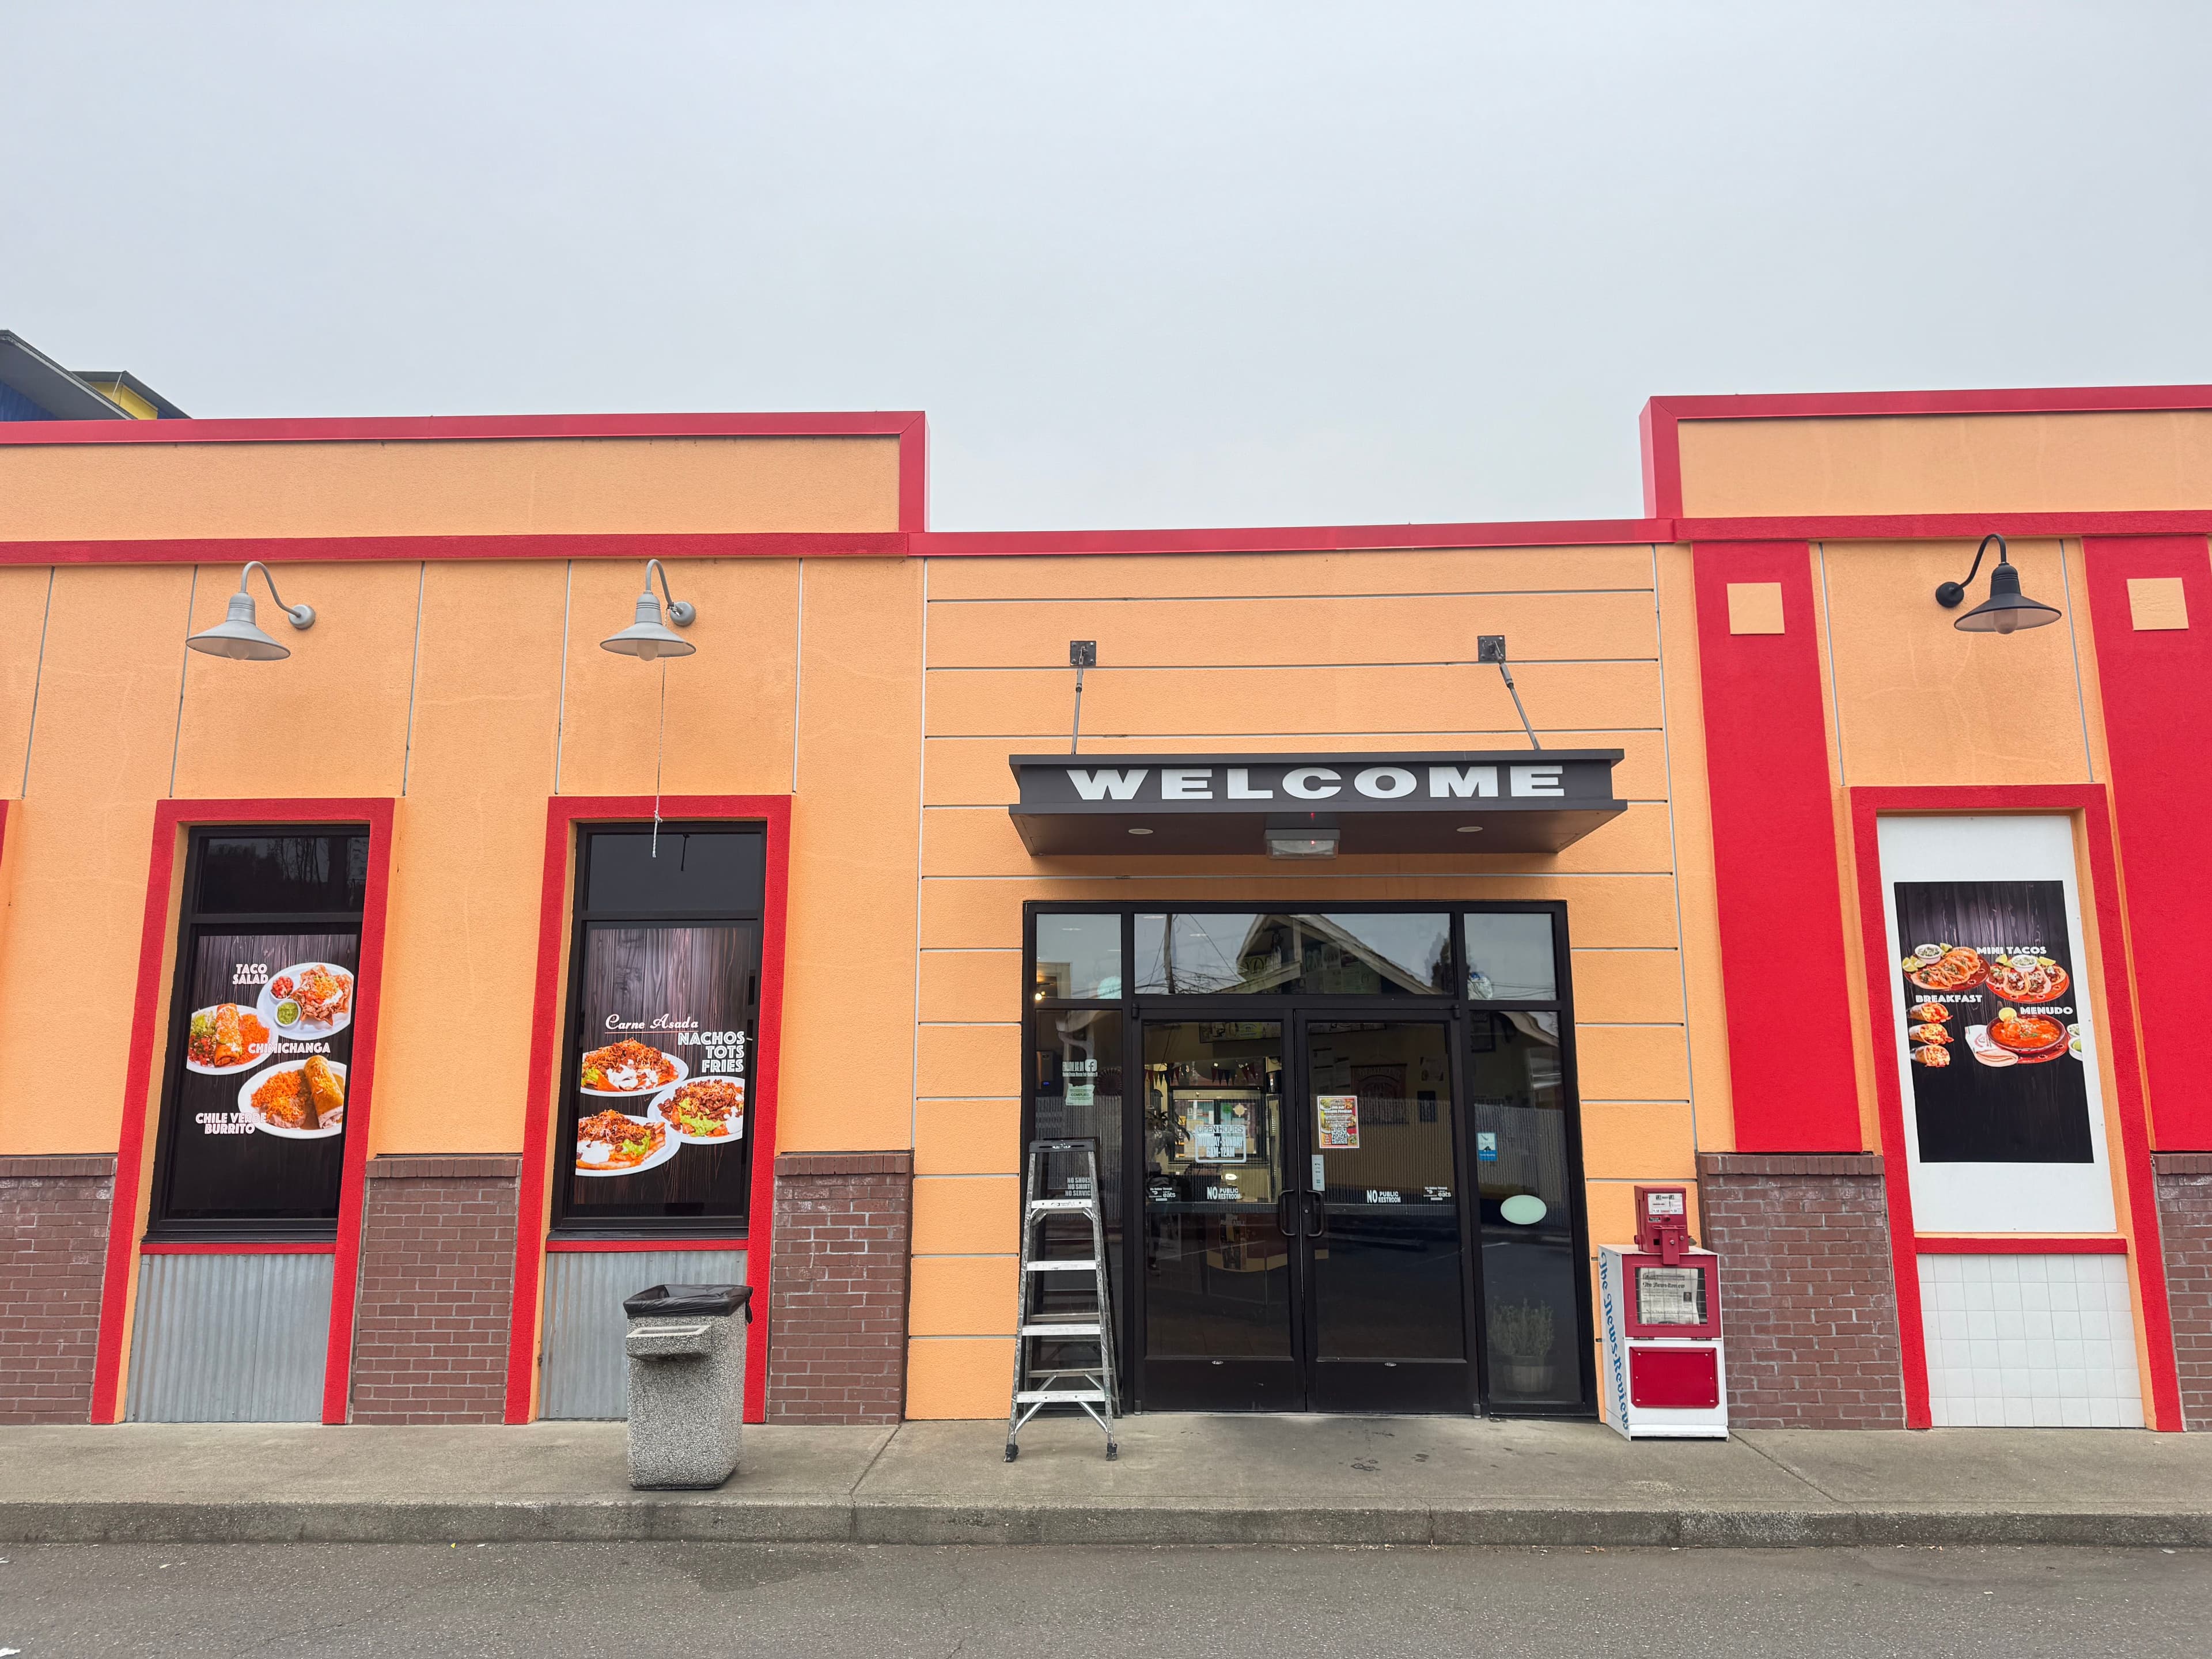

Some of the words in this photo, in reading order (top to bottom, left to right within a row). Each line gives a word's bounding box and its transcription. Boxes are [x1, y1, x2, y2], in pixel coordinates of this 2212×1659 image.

[1066, 765, 1566, 801] WELCOME
[1976, 946, 2004, 955] MINI
[2006, 946, 2047, 955] TACOS
[236, 964, 267, 974] TACO
[232, 974, 268, 984] SALAD
[1915, 995, 1983, 1003] BREAKFAST
[605, 1014, 645, 1029] Carne
[650, 1013, 699, 1029] Asada
[677, 1031, 745, 1046] NACHOS
[248, 1043, 331, 1054] CHIMICHANGA
[705, 1046, 745, 1059] TOTS
[702, 1059, 744, 1073] FRIES
[195, 1113, 228, 1123] CHILE
[230, 1113, 267, 1123] VERDE
[204, 1123, 255, 1134] BURRITO
[1207, 1186, 1218, 1200] NO
[1366, 1190, 1378, 1203] NO
[1599, 1252, 1608, 1290] The
